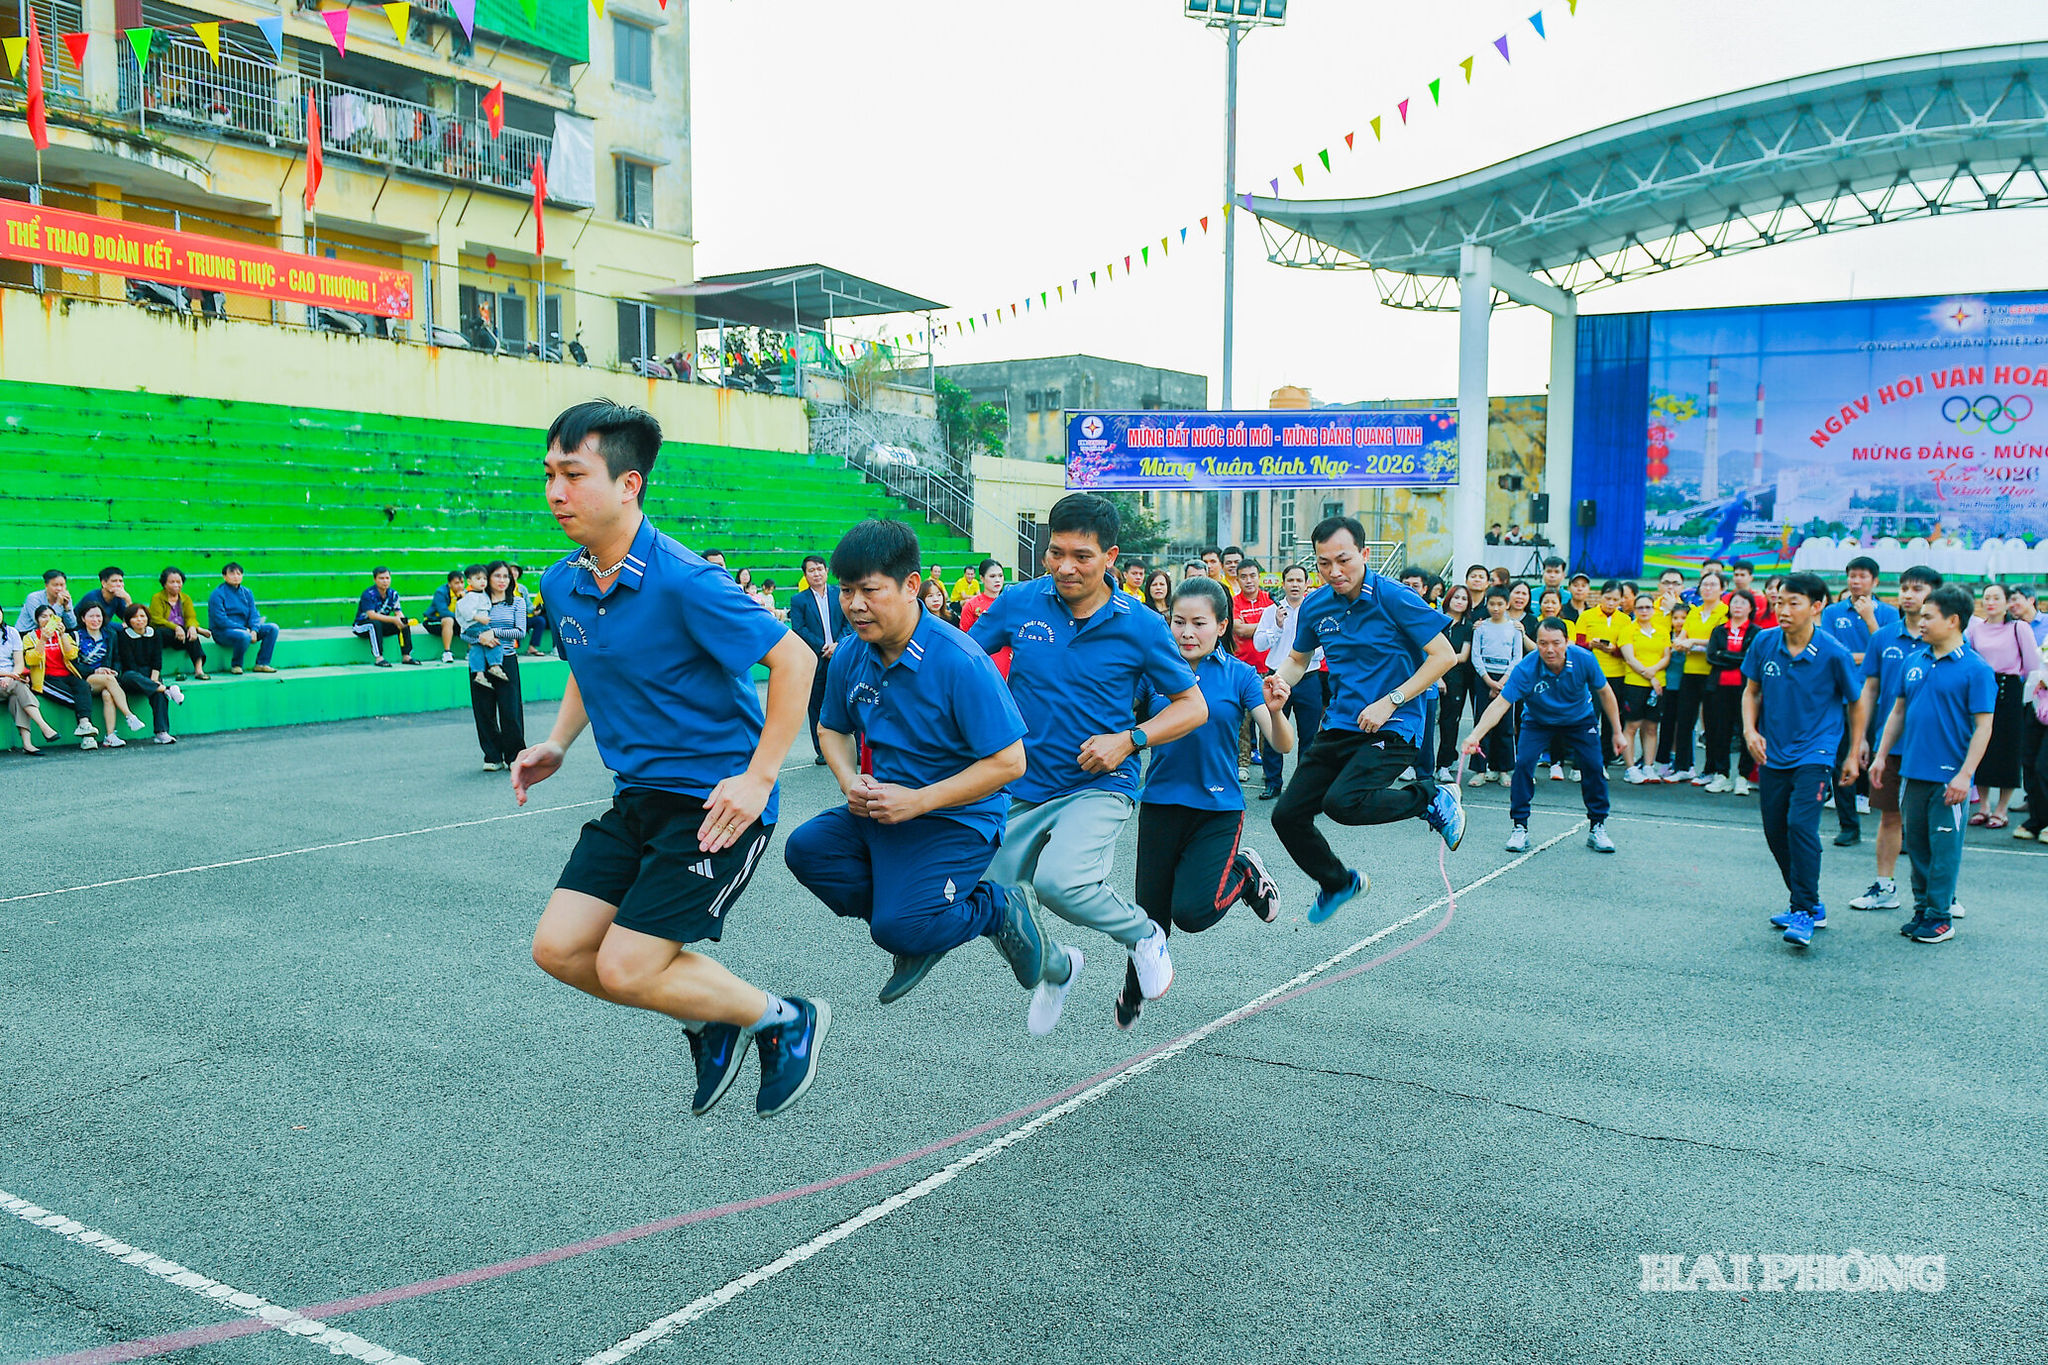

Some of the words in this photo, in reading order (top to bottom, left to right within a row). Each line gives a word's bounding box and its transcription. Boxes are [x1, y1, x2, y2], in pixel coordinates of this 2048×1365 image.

[6, 214, 41, 249] THỂ
[44, 226, 90, 257] THAO
[94, 234, 139, 265] ĐOÀN
[143, 239, 173, 271] KẾT
[187, 251, 236, 281] TRUNG
[239, 260, 275, 290] THỰC
[288, 269, 315, 293] CAO
[318, 273, 369, 304] THƯỢNG
[1128, 424, 1164, 447] MỪNG
[1166, 422, 1189, 447] ĐẤT
[1192, 424, 1224, 447] NƯỚC
[1227, 421, 1247, 447] ĐỔI
[1249, 424, 1272, 447] MỚI
[1283, 424, 1318, 446] MỪNG
[1320, 421, 1352, 446] ĐẢNG
[1355, 427, 1393, 448] QUANG
[1395, 427, 1422, 446] VINH
[1852, 443, 1912, 460] MỪNG
[1918, 441, 1974, 459] ĐẢNG
[1994, 441, 2048, 459] MỪN
[1201, 456, 1256, 475] Xuân
[1259, 455, 1307, 475] Bính
[1310, 455, 1352, 480] Ngọ
[1366, 454, 1415, 475] 2026
